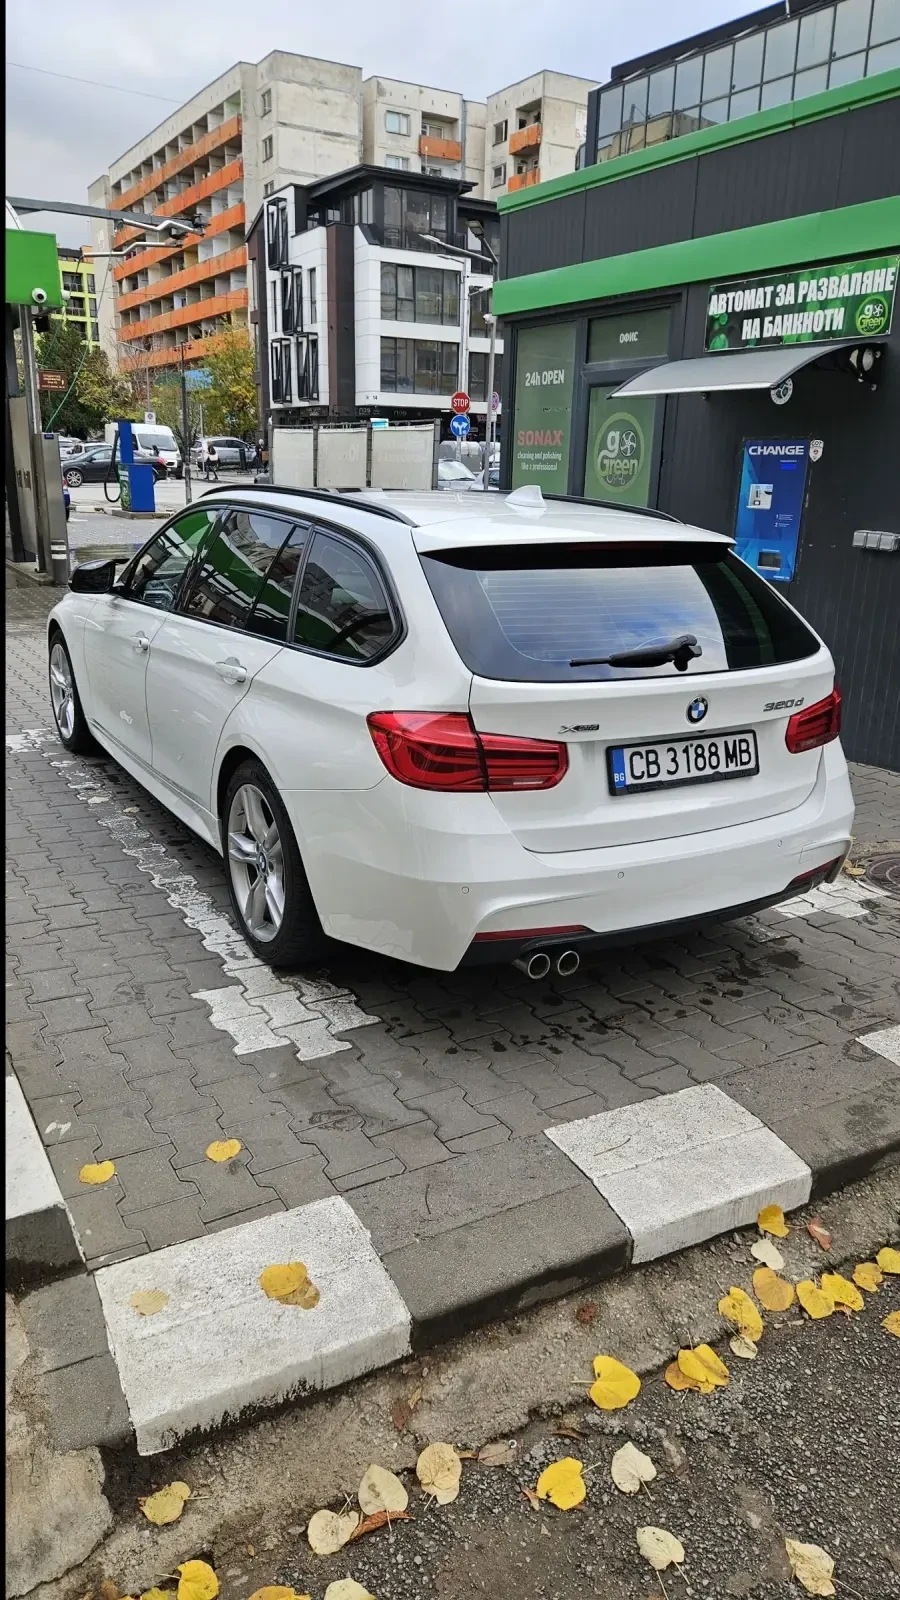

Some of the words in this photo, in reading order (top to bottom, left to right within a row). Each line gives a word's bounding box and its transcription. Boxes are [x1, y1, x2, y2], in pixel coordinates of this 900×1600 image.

[708, 285, 774, 315] АВТОМАТ
[775, 282, 796, 306] ЗА
[799, 267, 896, 302] РАЗВАЛЯНЕ
[741, 317, 761, 340] НА
[763, 307, 845, 337] БАНКНОТИ
[619, 331, 639, 343] ОФИС
[525, 371, 541, 386] 24h
[542, 369, 565, 385] OPEN
[453, 398, 469, 407] STOP
[517, 430, 562, 446] SONAX
[517, 451, 534, 460] cleaning
[748, 445, 805, 455] CHANGE
[532, 462, 558, 471] professional
[597, 450, 638, 477] Green
[762, 697, 805, 712] 320d
[629, 749, 661, 780] CB
[666, 742, 721, 776] 3188
[724, 738, 752, 769] MB
[614, 772, 625, 783] BG
